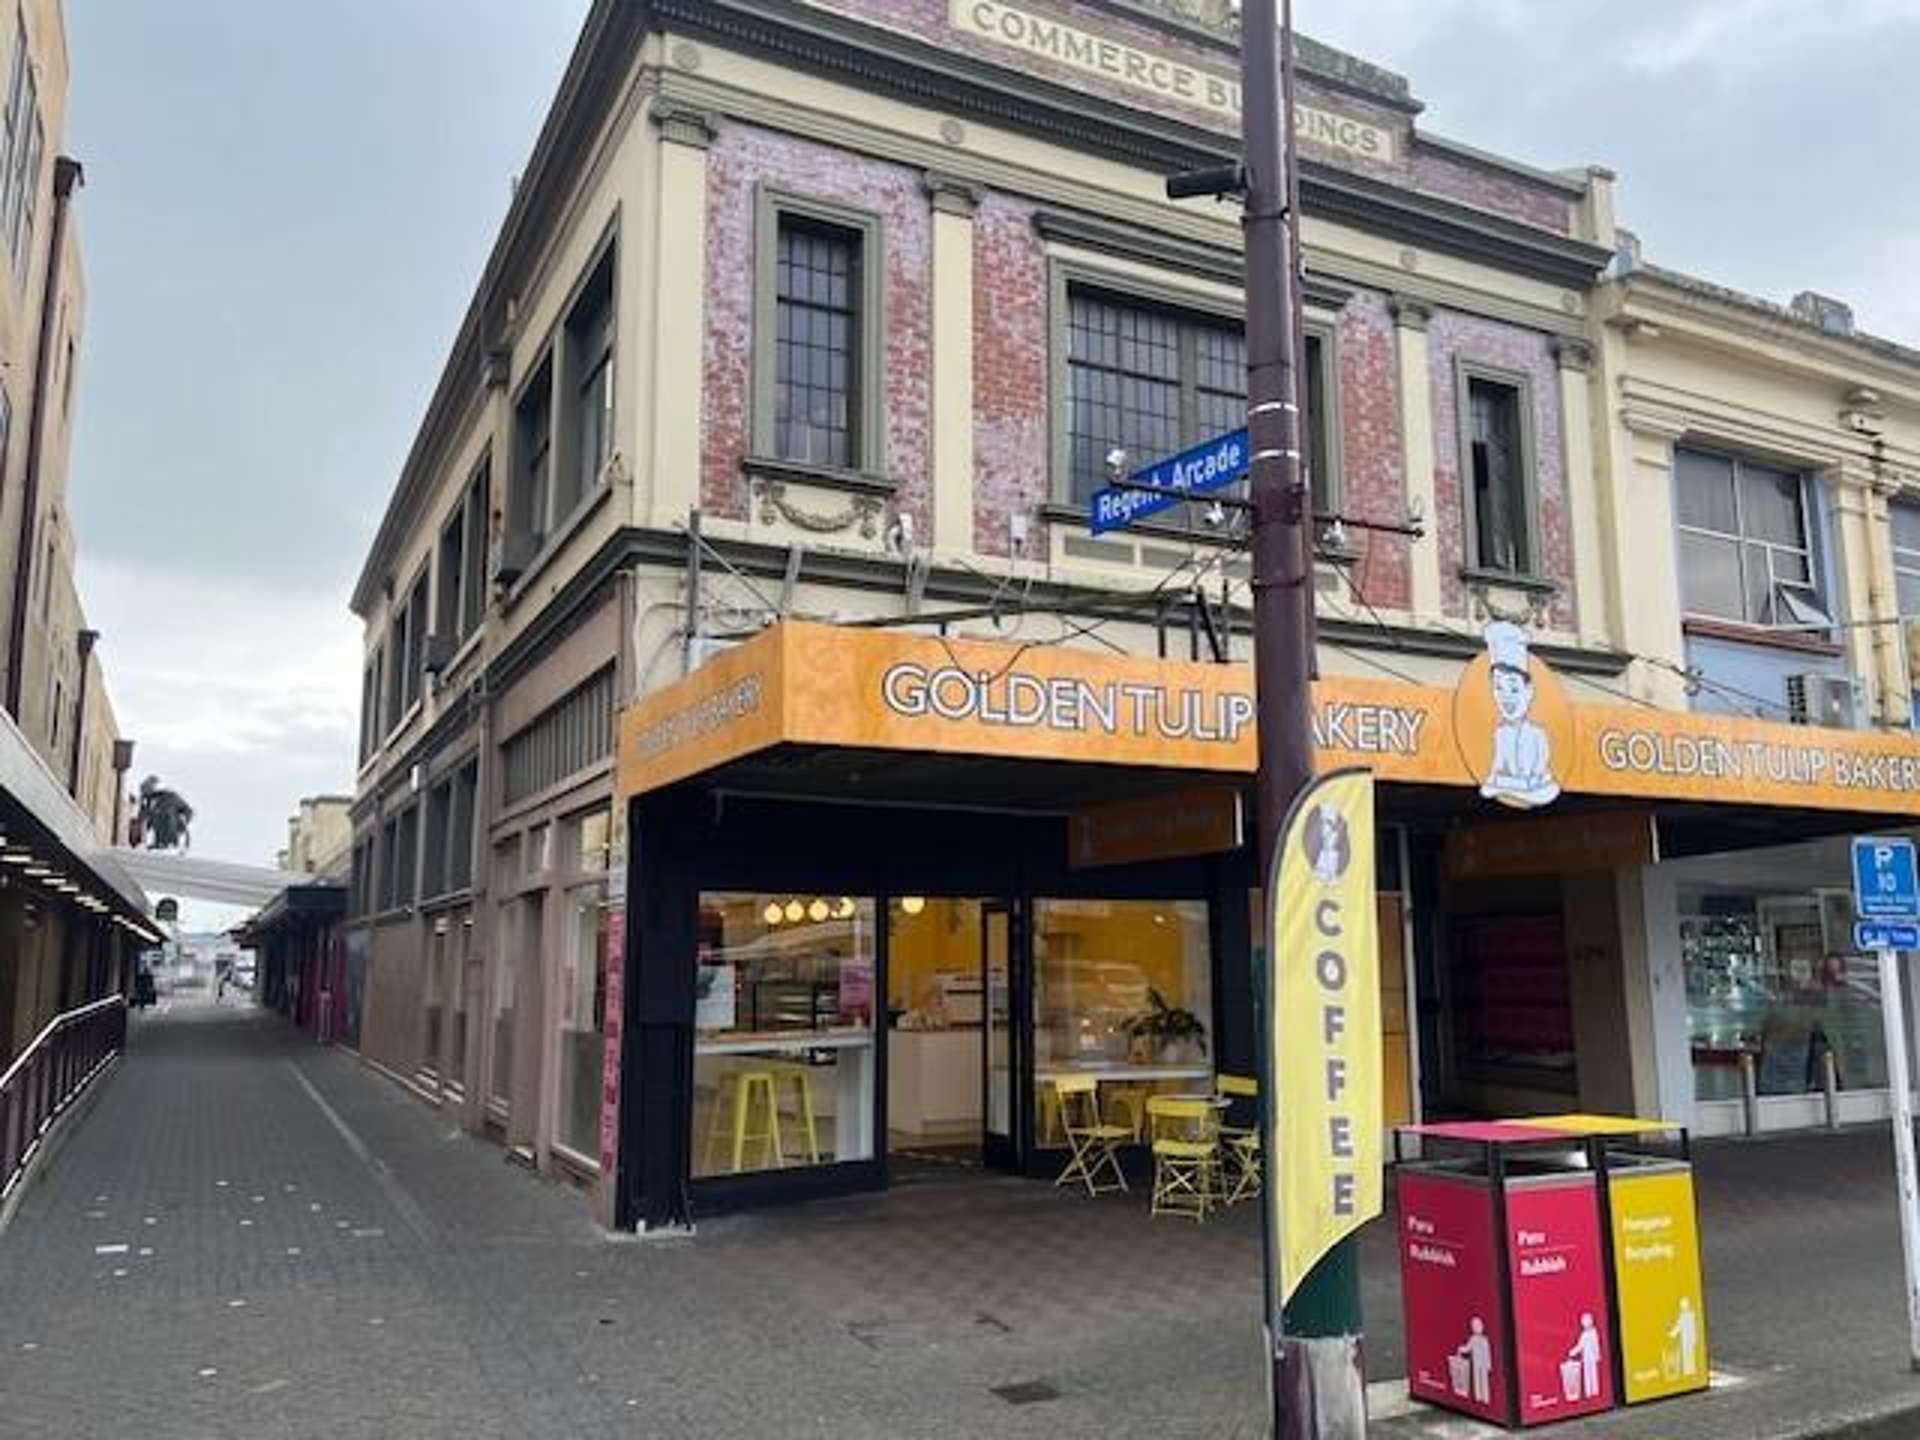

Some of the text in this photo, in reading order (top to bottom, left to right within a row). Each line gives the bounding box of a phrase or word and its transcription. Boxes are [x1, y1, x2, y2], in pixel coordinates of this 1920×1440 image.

[972, 2, 1379, 152] COMMERCE BINGS
[1171, 442, 1241, 488] Arcade
[882, 661, 1428, 755] GOLDEN TULIP KERY
[1600, 729, 1741, 777] GOLDEN
[1745, 742, 1826, 784] TULIP
[1314, 899, 1354, 1216] COFFEE
